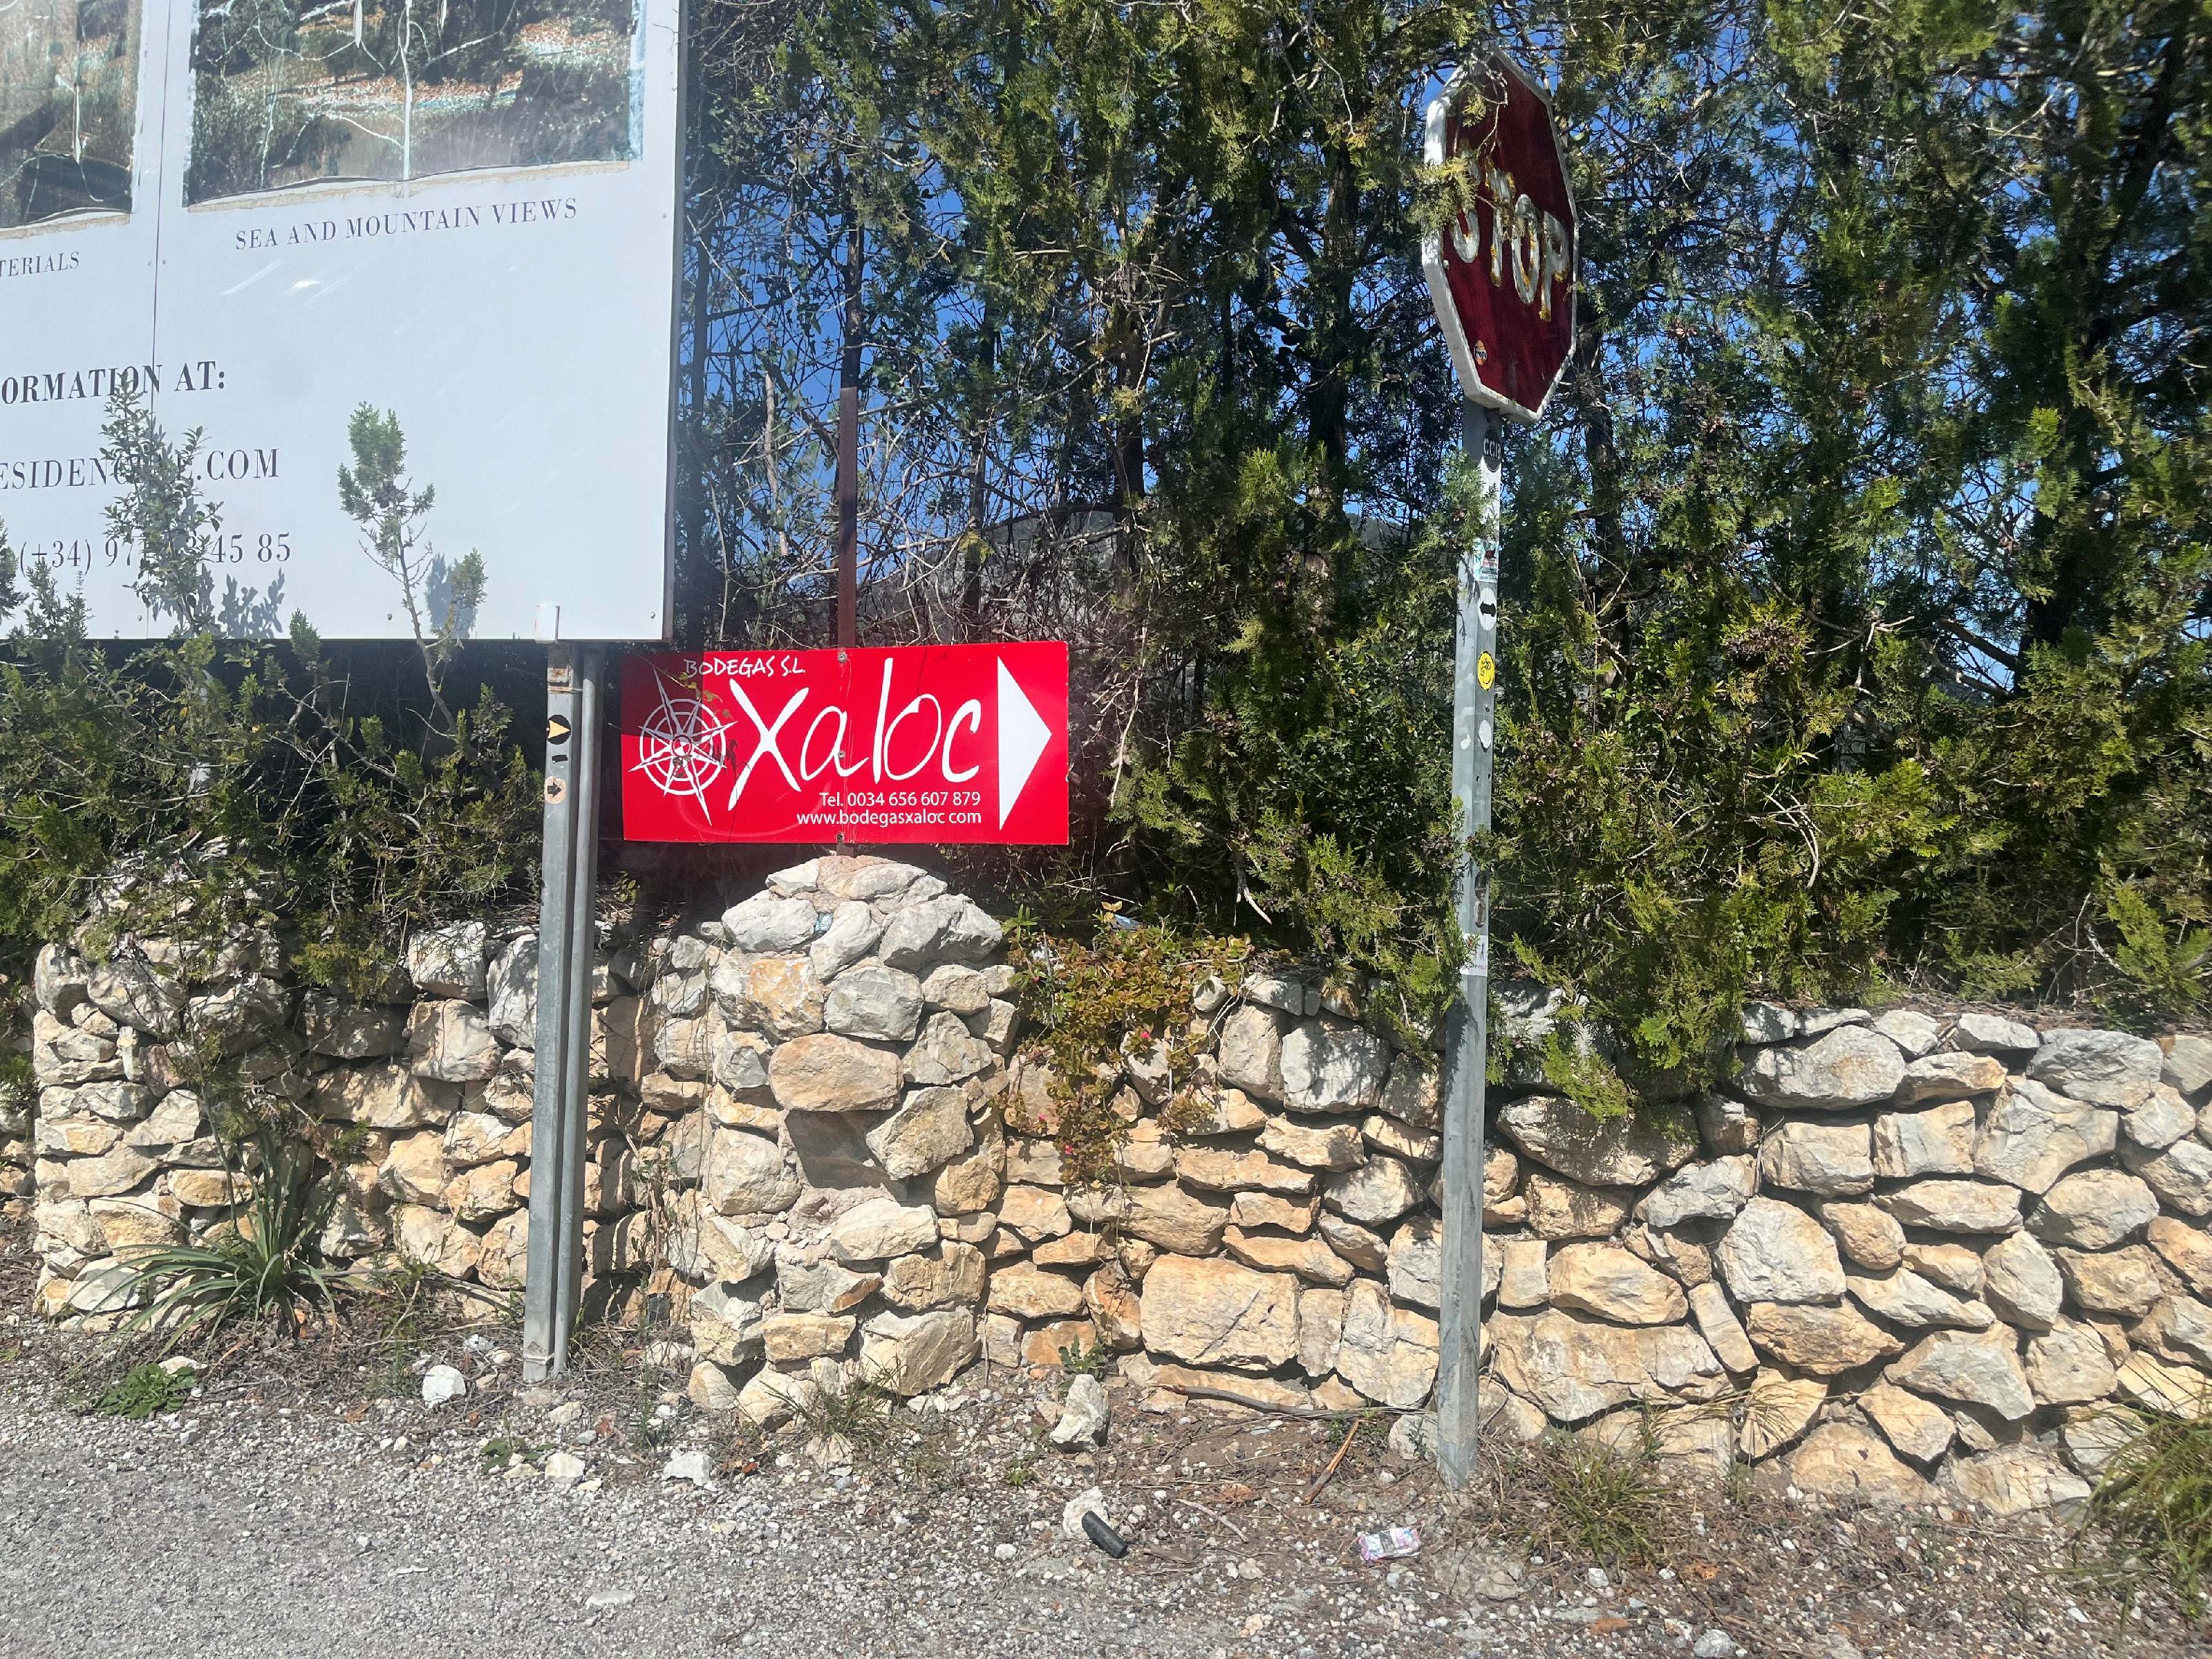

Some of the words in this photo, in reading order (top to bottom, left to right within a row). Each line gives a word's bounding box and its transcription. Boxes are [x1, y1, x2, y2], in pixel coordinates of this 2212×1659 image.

[236, 228, 278, 250] SEA
[287, 221, 337, 245] AND
[345, 205, 482, 238] MOUNTAIN
[490, 198, 577, 225] VIEWS
[174, 361, 225, 392] AT:
[20, 538, 91, 578] (+34)
[211, 534, 243, 564] 45
[258, 532, 291, 563] 85
[684, 655, 776, 678] BODEGAS
[728, 657, 982, 812] Xaloc
[819, 792, 843, 807] Tel.
[847, 792, 885, 807] 0034
[888, 791, 917, 806] 656
[921, 791, 948, 806] 607
[953, 791, 981, 806] 879
